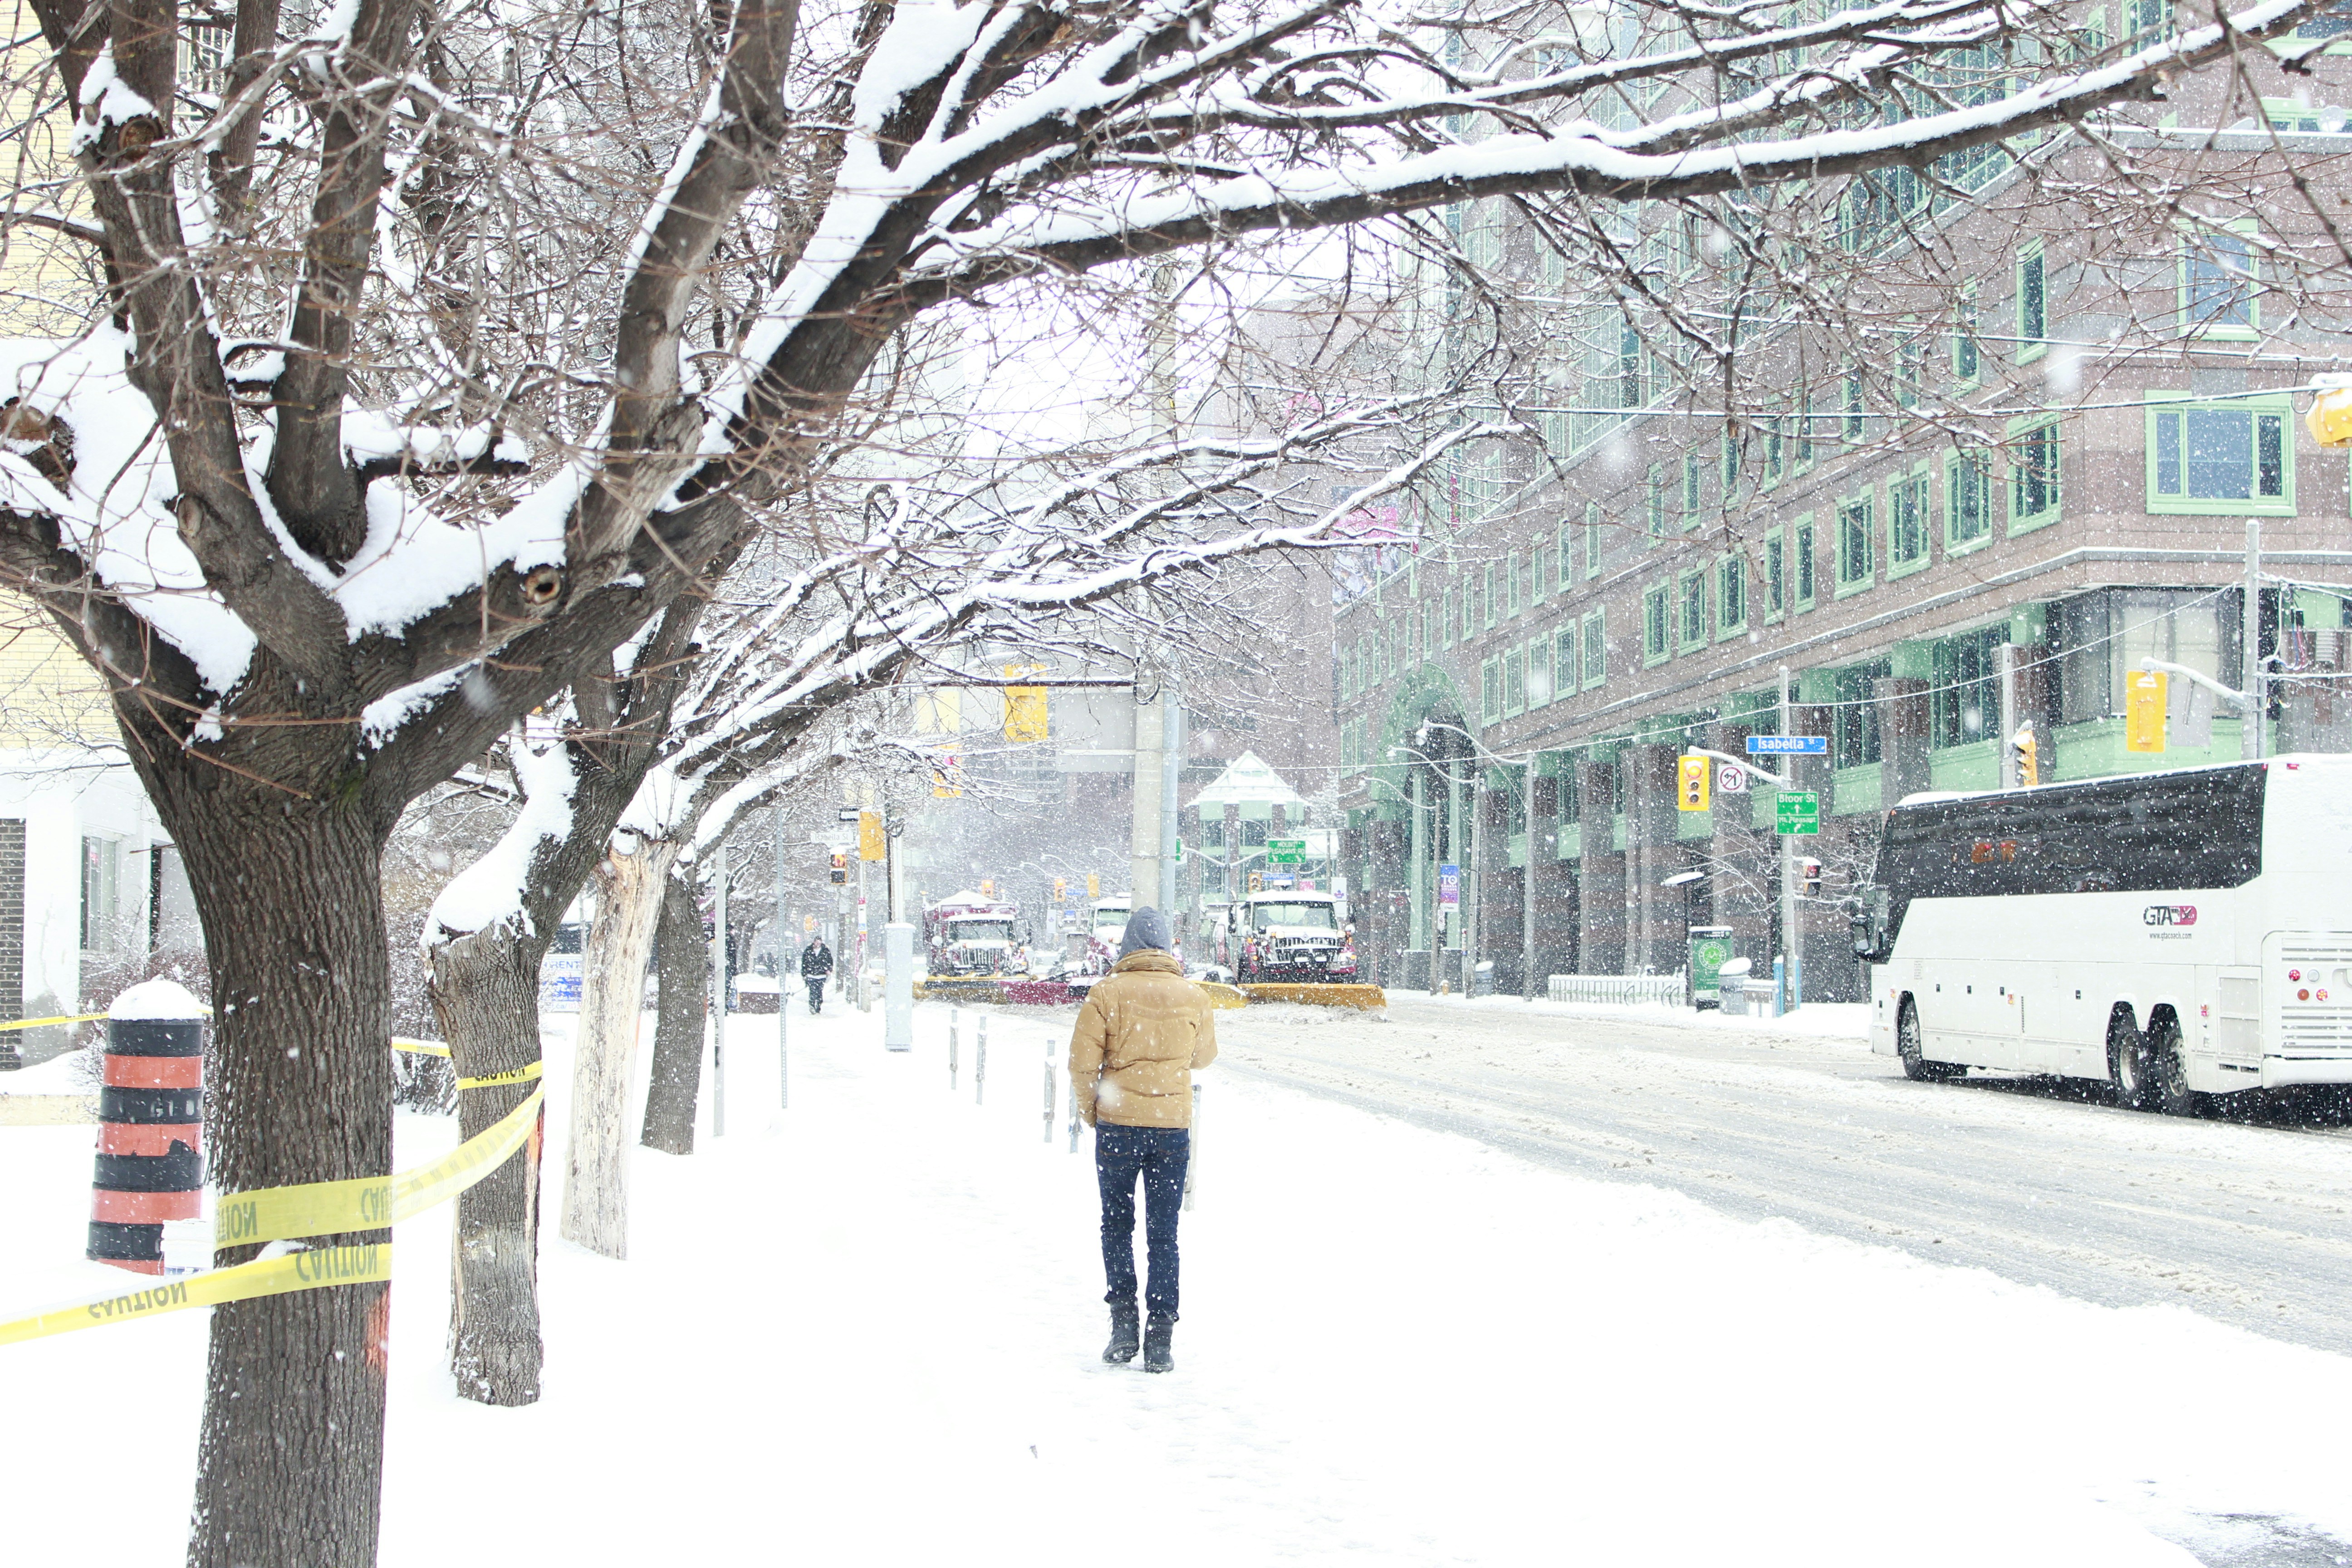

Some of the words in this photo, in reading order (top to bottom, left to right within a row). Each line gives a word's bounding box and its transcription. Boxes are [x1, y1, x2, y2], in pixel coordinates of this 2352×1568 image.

[1758, 738, 1804, 749] Isabella
[1779, 794, 1803, 803] Bloor
[1806, 794, 1815, 803] St
[1441, 875, 1457, 885] TO
[2143, 906, 2173, 926] GTA
[2149, 931, 2192, 941] www.gtacoach.com
